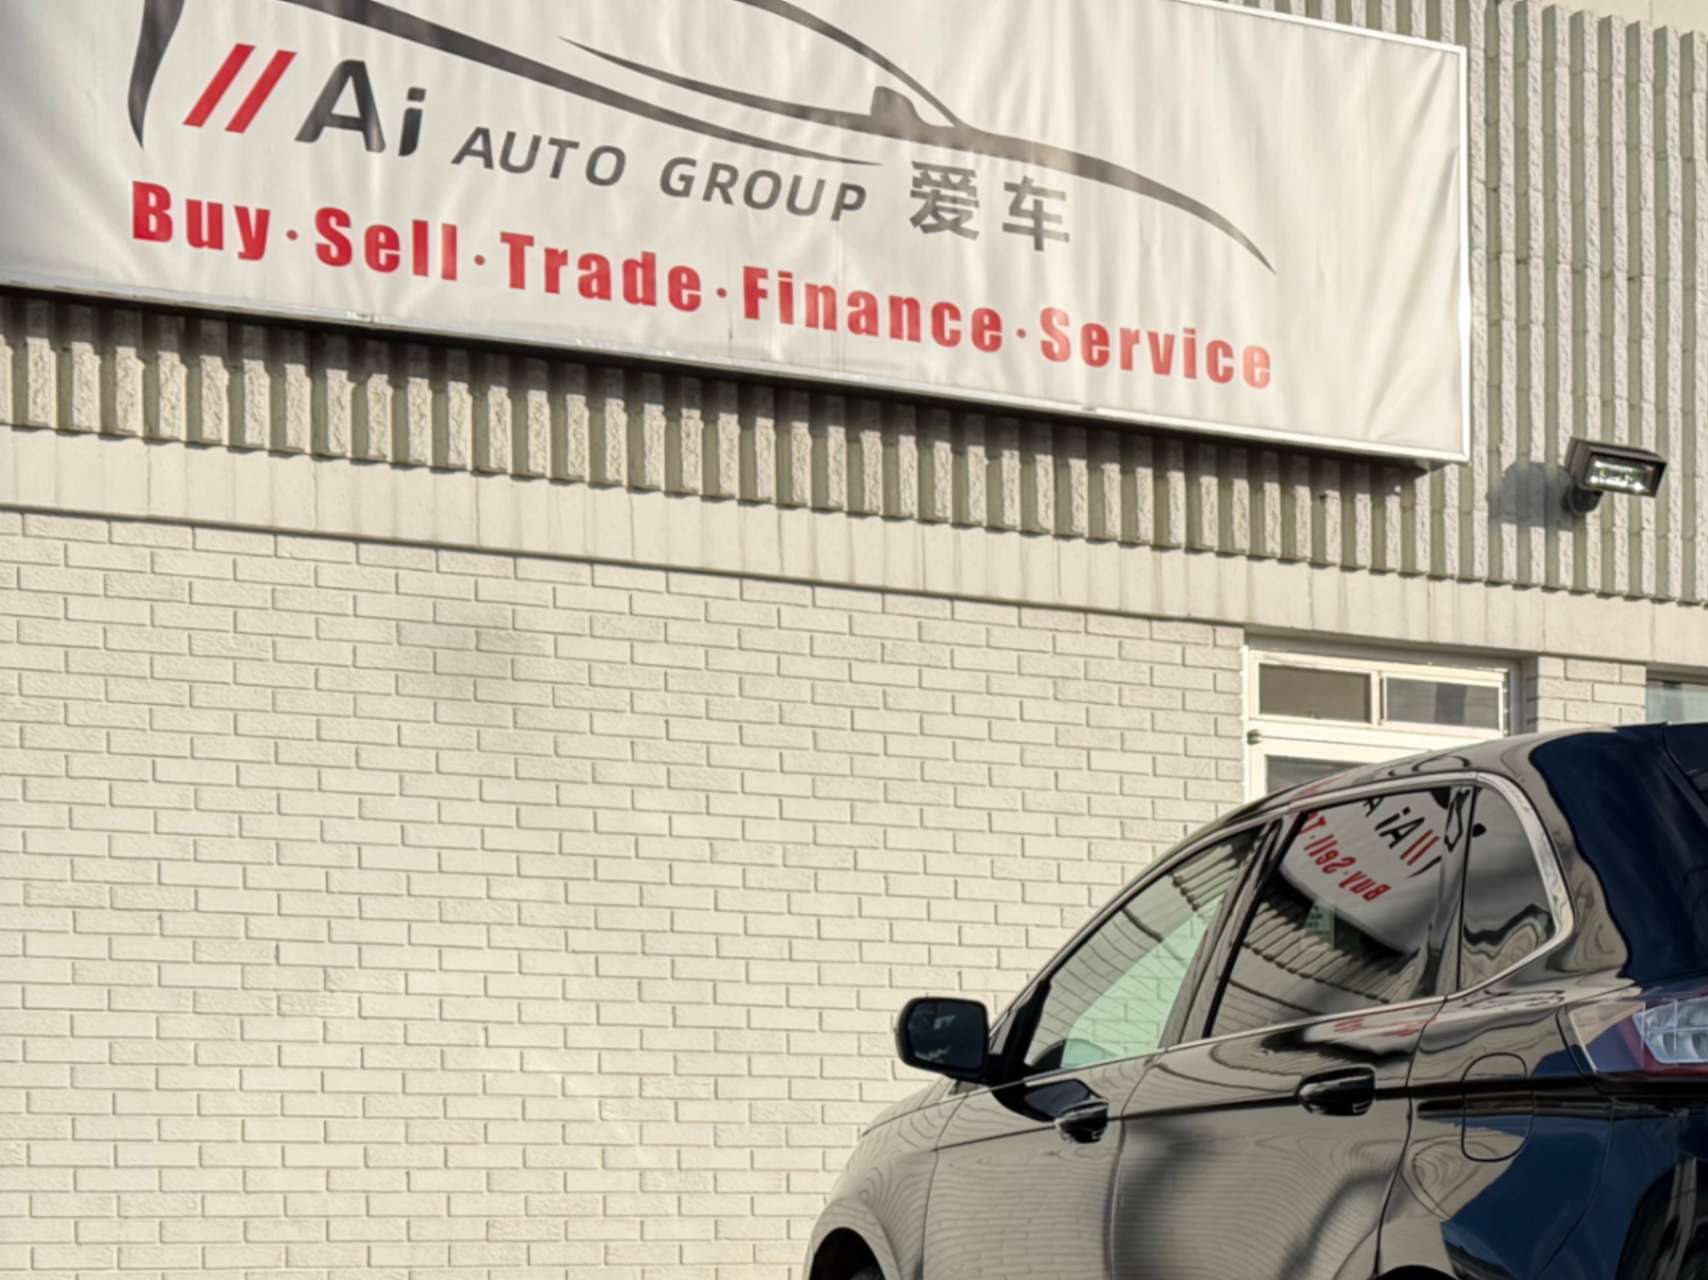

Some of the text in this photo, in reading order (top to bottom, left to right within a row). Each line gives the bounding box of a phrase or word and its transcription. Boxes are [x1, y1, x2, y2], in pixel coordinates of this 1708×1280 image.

[451, 126, 627, 187] AUTO
[659, 156, 867, 222] GROUP
[909, 160, 1071, 252] 爱车
[1040, 305, 1272, 390] Service
